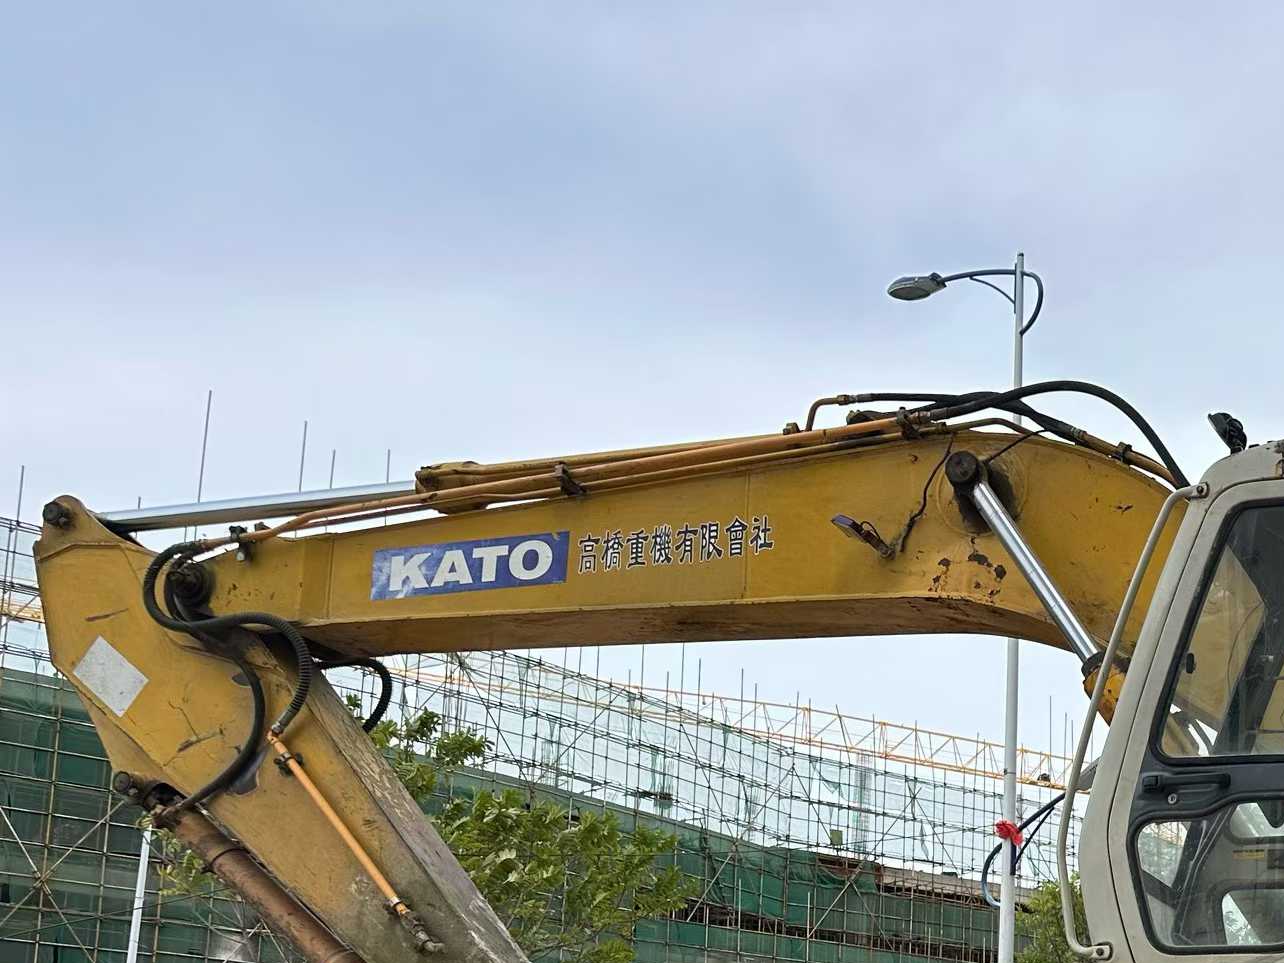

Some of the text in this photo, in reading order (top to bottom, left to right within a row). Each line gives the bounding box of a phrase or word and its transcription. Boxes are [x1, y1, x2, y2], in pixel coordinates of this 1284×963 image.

[389, 539, 553, 592] KATO
[578, 515, 775, 575] 高橋重機有限會社
